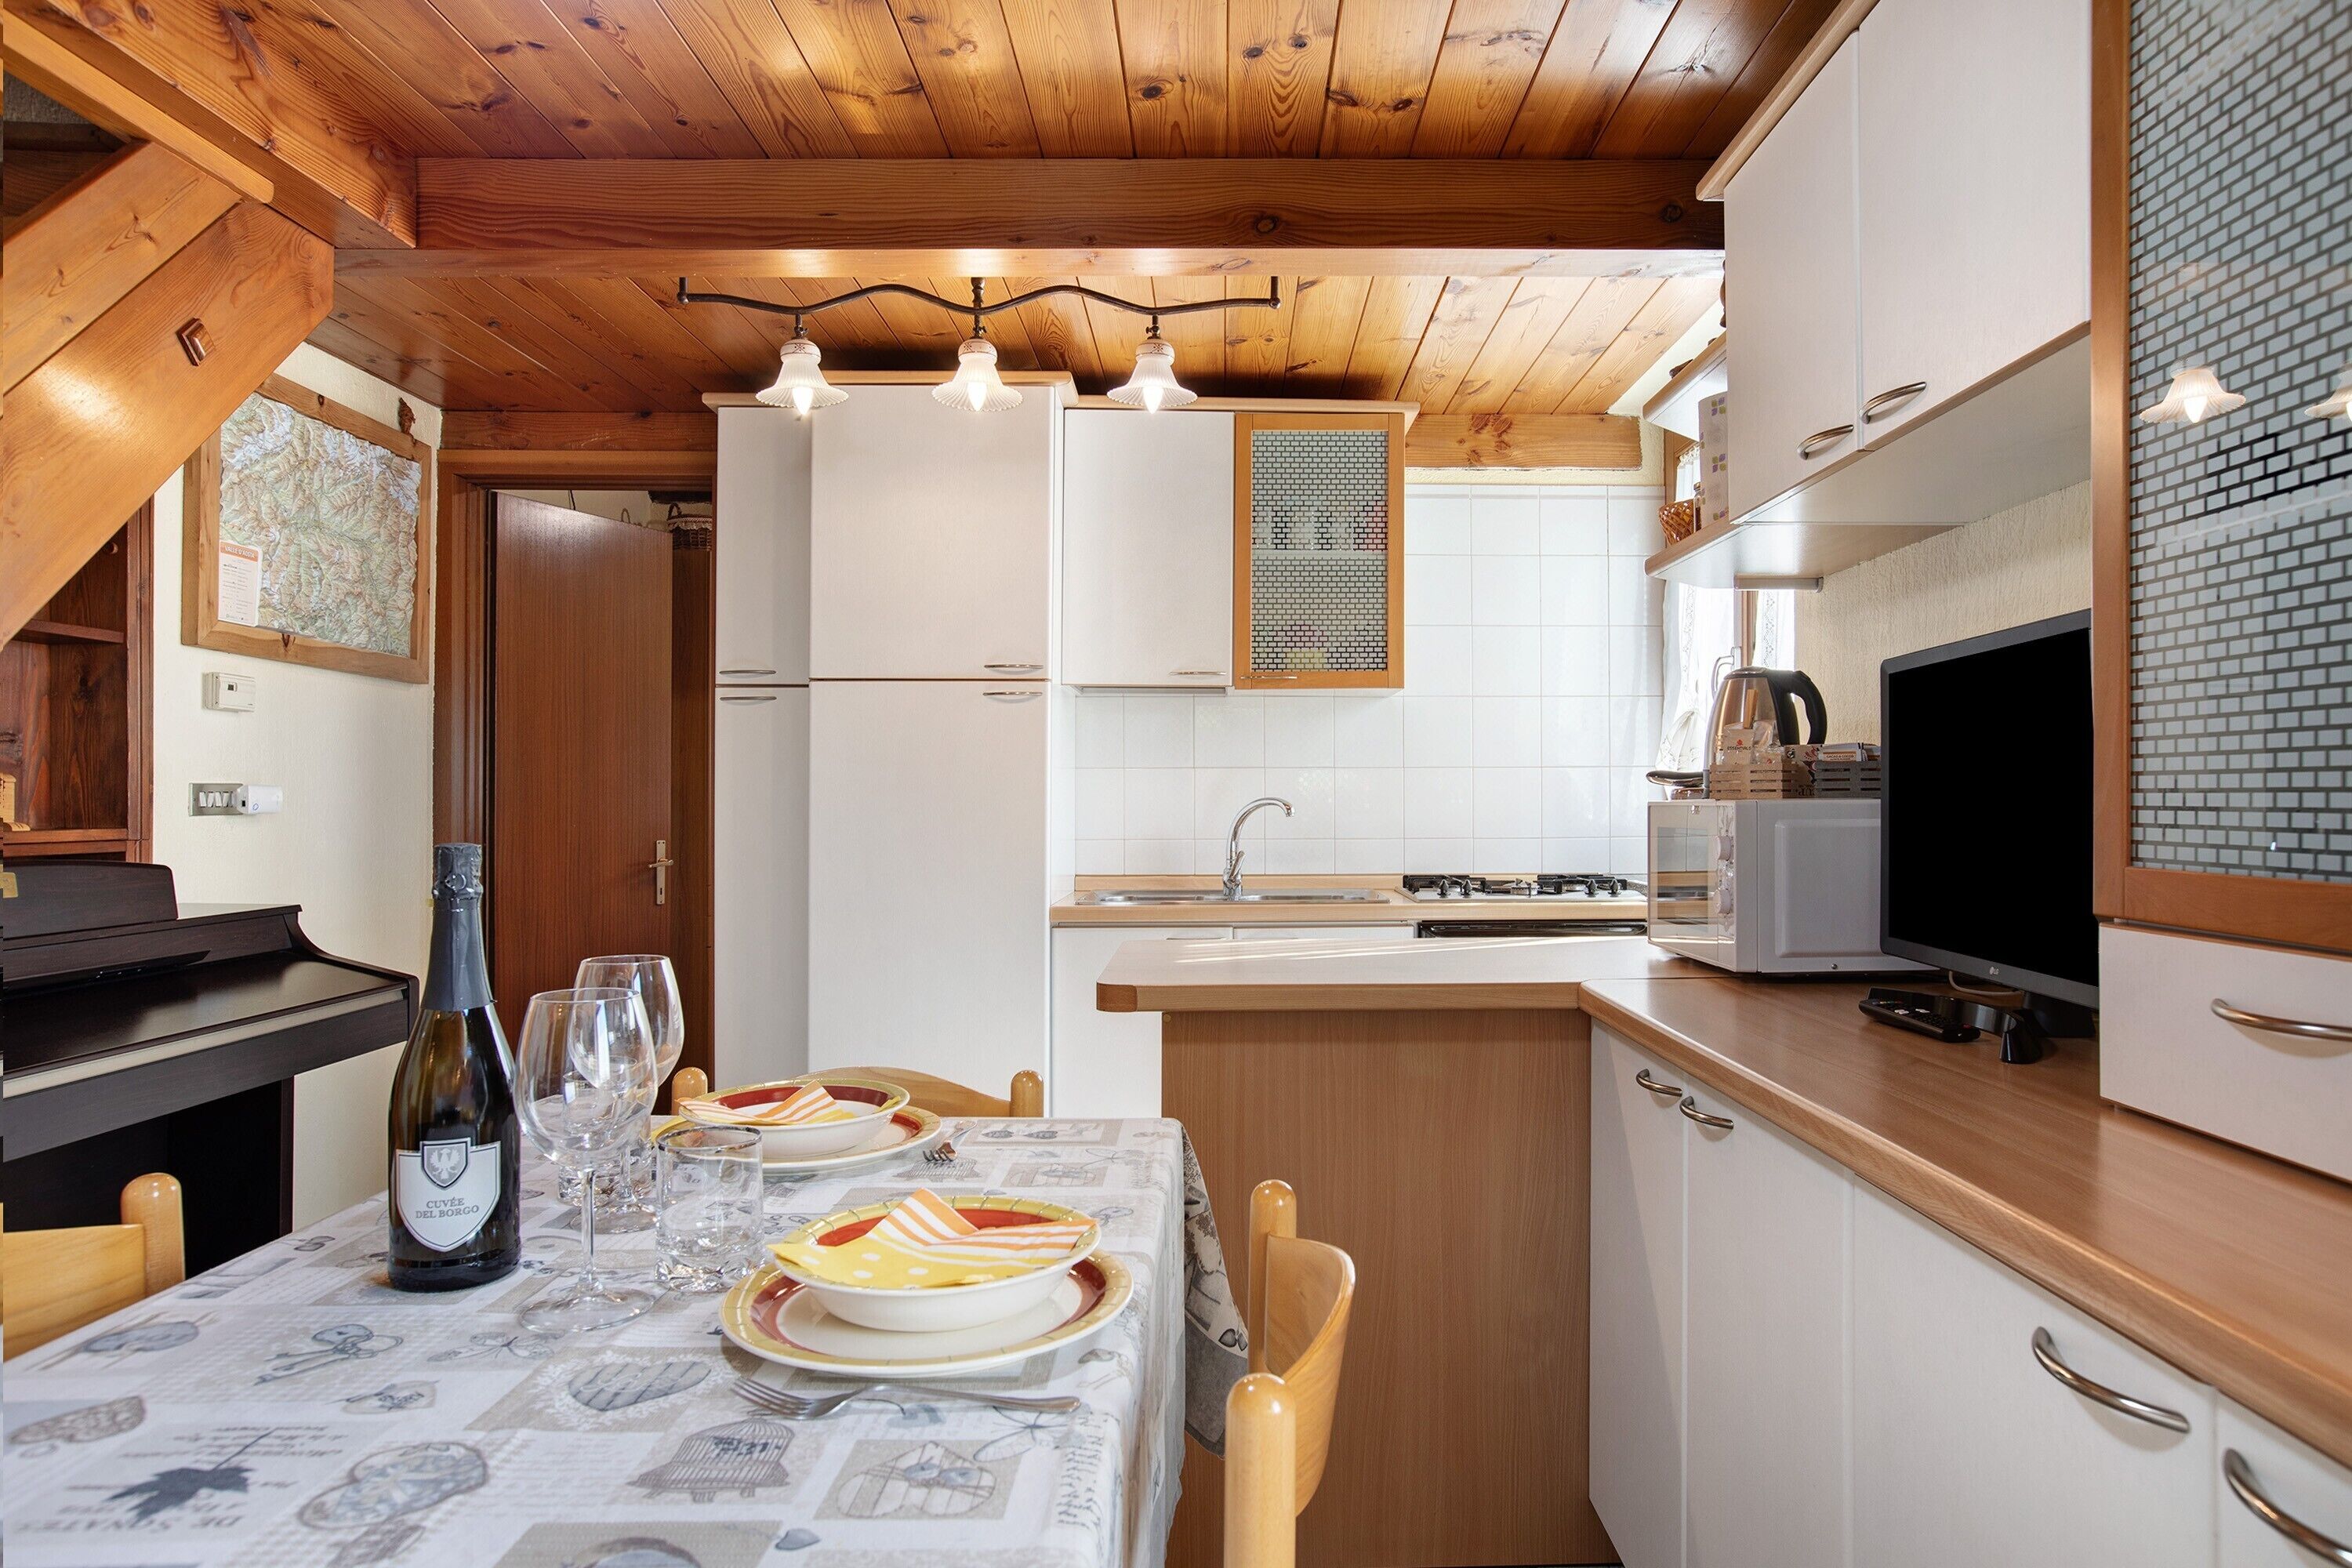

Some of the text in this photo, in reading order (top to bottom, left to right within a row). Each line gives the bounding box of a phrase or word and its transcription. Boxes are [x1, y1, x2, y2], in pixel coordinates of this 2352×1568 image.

[426, 1196, 466, 1209] CUVÉE
[415, 1204, 479, 1219] DEL BORGO
